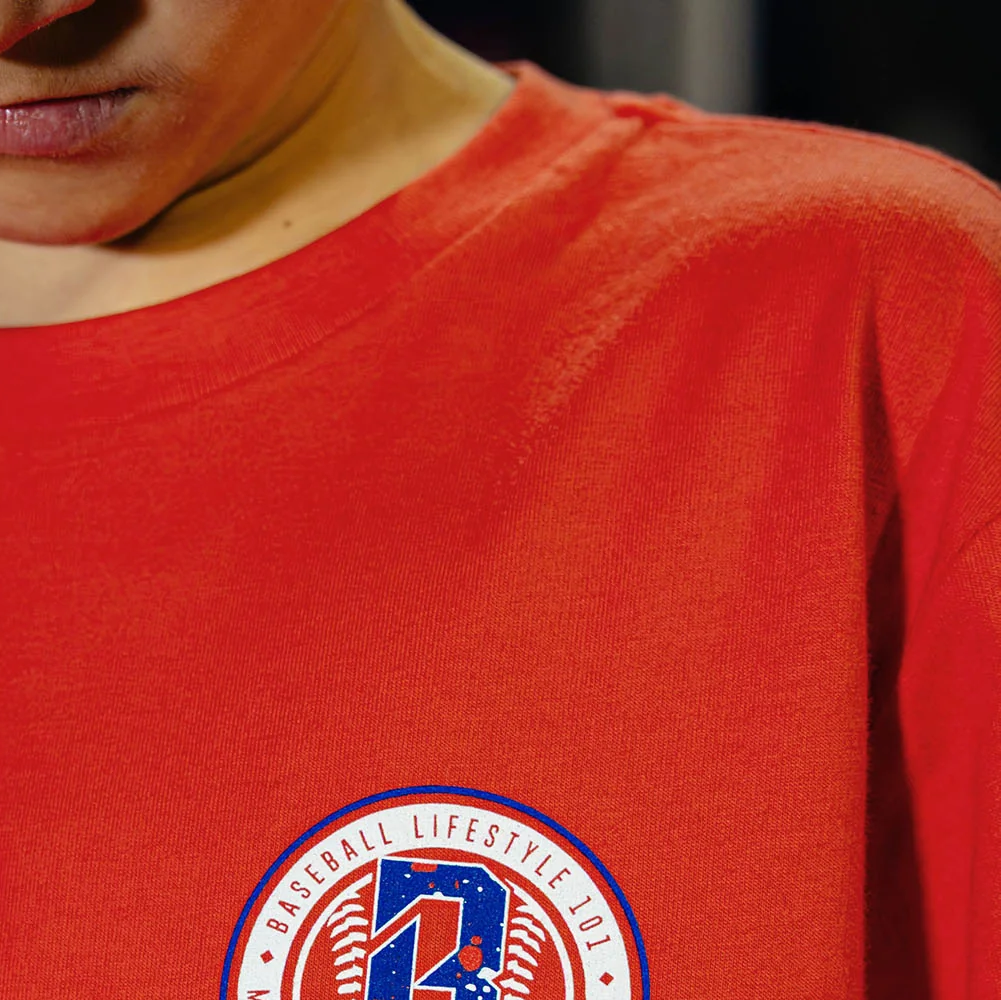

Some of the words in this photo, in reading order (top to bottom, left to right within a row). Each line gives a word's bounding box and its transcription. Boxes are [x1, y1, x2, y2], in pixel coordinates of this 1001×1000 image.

[267, 821, 393, 935] BASEBALL
[413, 815, 570, 891] LIFESTYLE
[568, 895, 611, 952] 101
